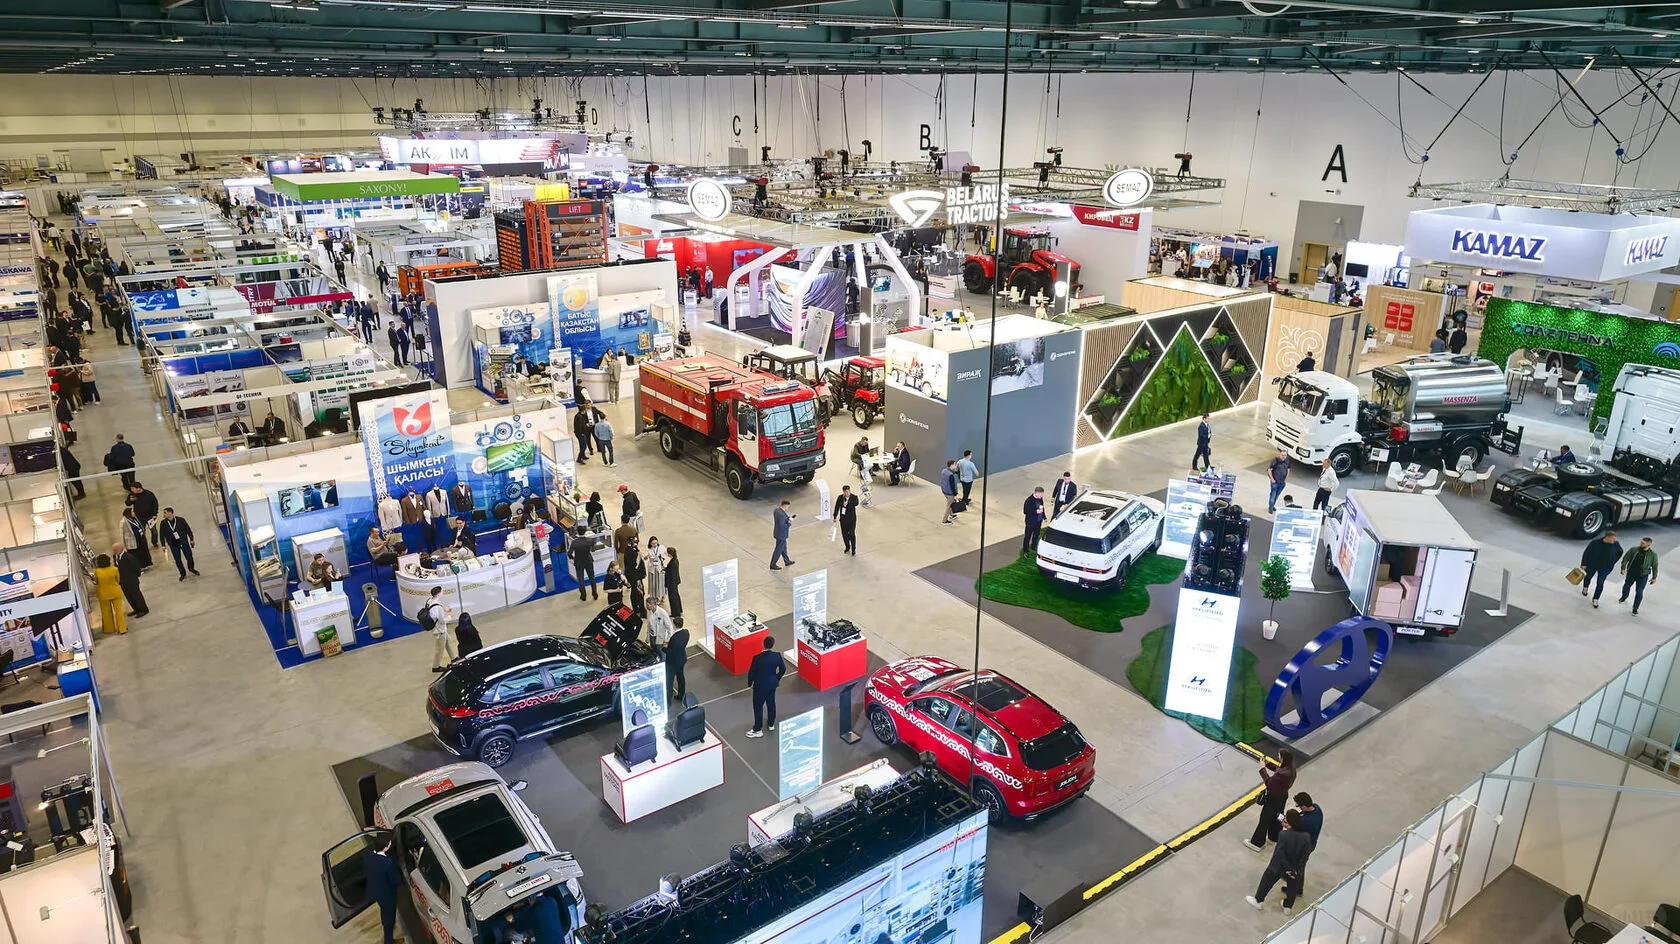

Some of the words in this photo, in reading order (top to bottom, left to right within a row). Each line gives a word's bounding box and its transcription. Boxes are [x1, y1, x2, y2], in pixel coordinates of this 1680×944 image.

[592, 108, 598, 125] D
[732, 115, 742, 136] C
[919, 124, 932, 151] B
[1322, 144, 1347, 183] A
[360, 183, 407, 195] SAXONY!
[947, 183, 1009, 207] BELARUS
[1116, 182, 1142, 194] SEMAZ
[568, 205, 582, 213] LIFT
[1452, 230, 1545, 261] KAMAZ
[1626, 236, 1668, 265] KAMAZ
[251, 300, 277, 310] MOTUL
[560, 318, 599, 328] ҚАЗАҚСТАН
[565, 326, 597, 335] ОБЛЫСЫ
[1443, 395, 1478, 404] MASSENZA
[383, 434, 445, 458] Shymkent
[386, 454, 448, 475] ШЫМКЕНТ
[393, 467, 445, 486] ҚАЛАСЫ
[800, 649, 819, 666] MOTORS
[1059, 774, 1078, 788] JOLION
